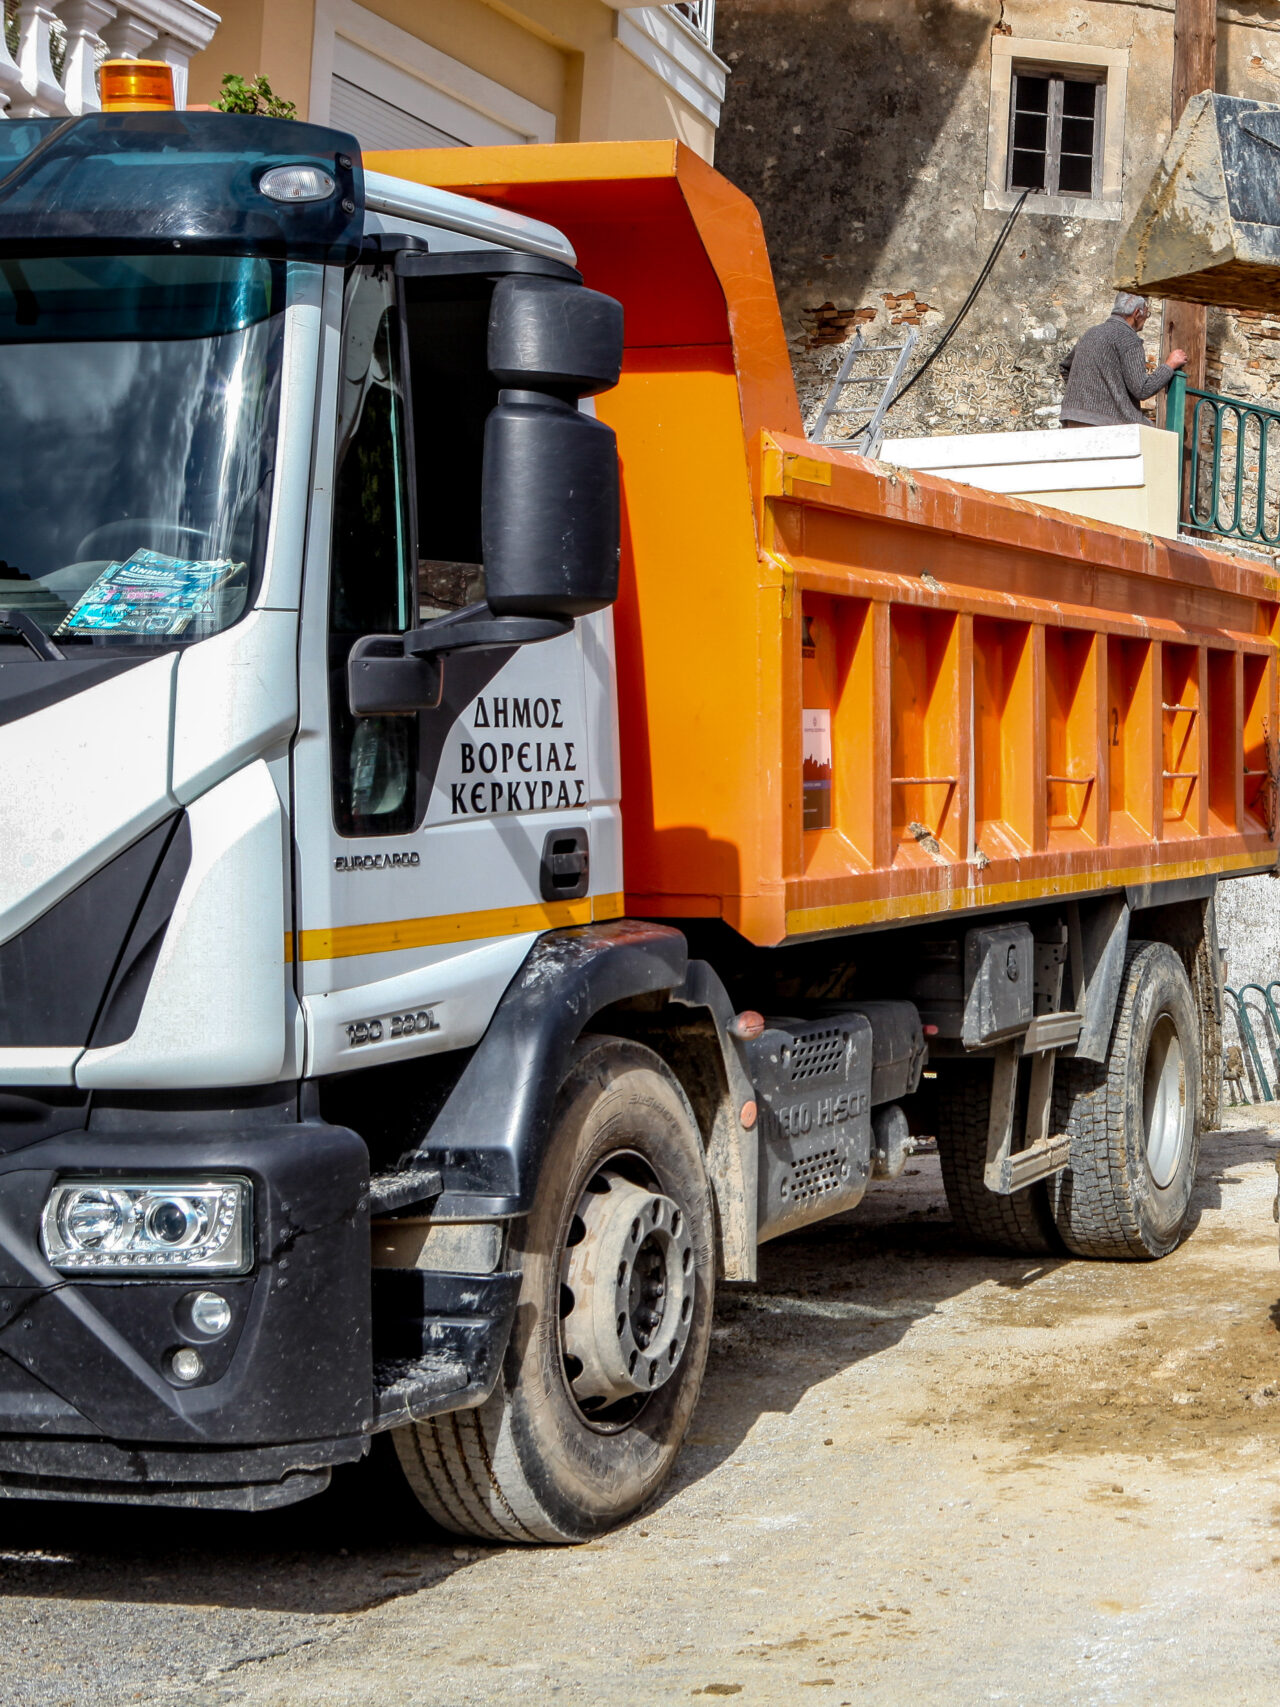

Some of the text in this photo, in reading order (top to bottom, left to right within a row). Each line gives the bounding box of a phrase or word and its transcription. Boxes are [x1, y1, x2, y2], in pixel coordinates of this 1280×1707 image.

[474, 697, 564, 728] ΔΗΜΟΣ
[461, 742, 576, 774] ΒΟΡΕΙΑΣ
[451, 780, 587, 814] ΚΕΡΚΥΡΑΣ
[334, 852, 420, 872] EUROCARGO
[345, 1019, 383, 1046] 190
